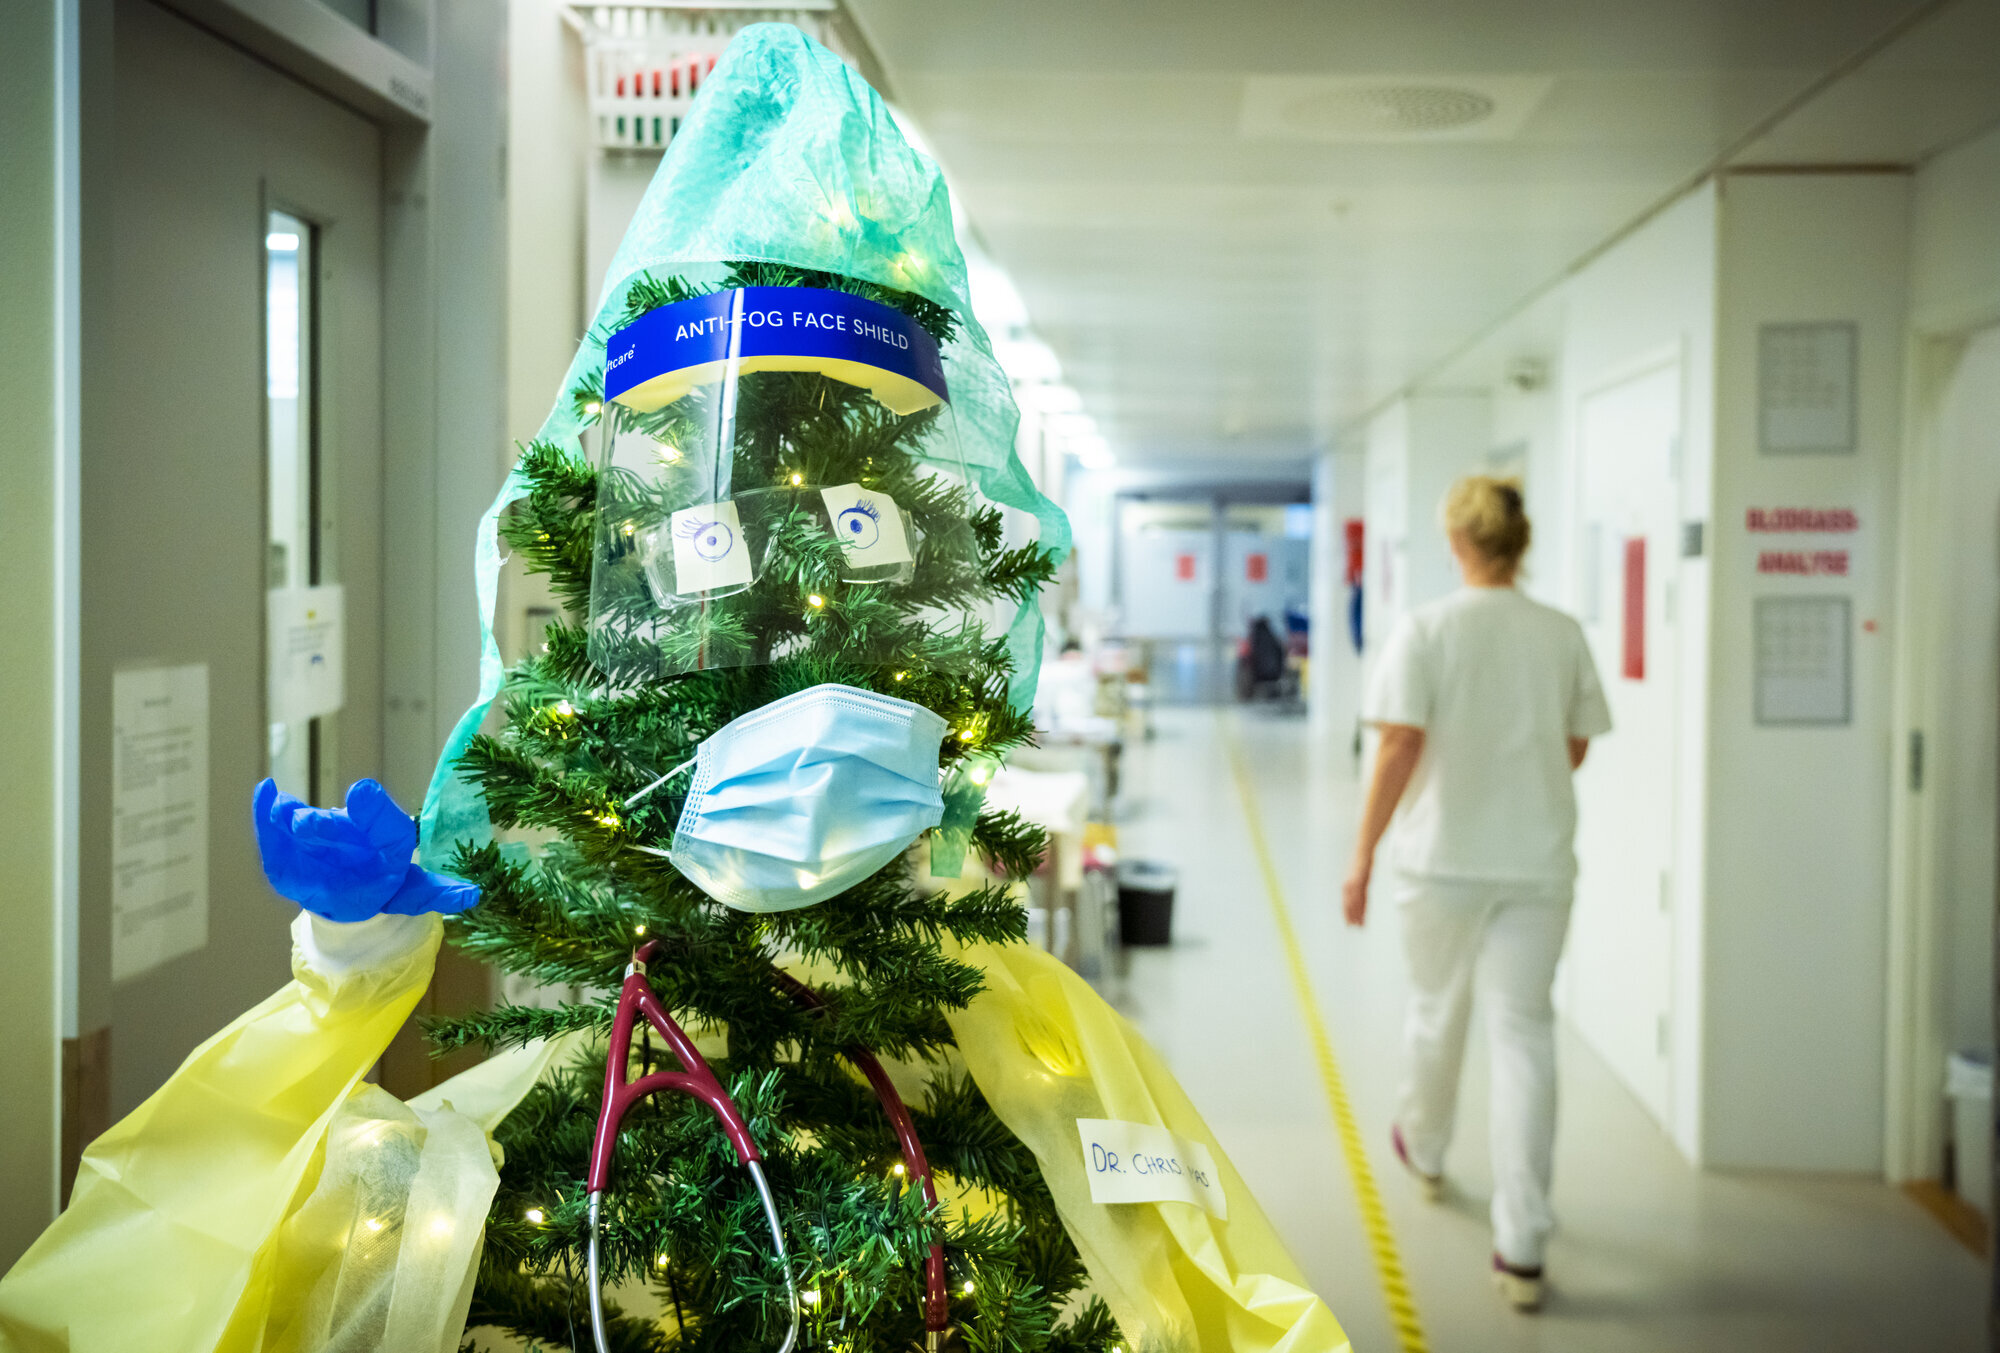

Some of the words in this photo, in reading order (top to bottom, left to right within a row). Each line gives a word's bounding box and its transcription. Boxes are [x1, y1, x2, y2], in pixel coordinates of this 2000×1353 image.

[792, 311, 847, 332] FACE
[853, 318, 909, 350] SHIELD
[1091, 1142, 1127, 1173] DR.
[1132, 1153, 1210, 1188] CHRISAS
